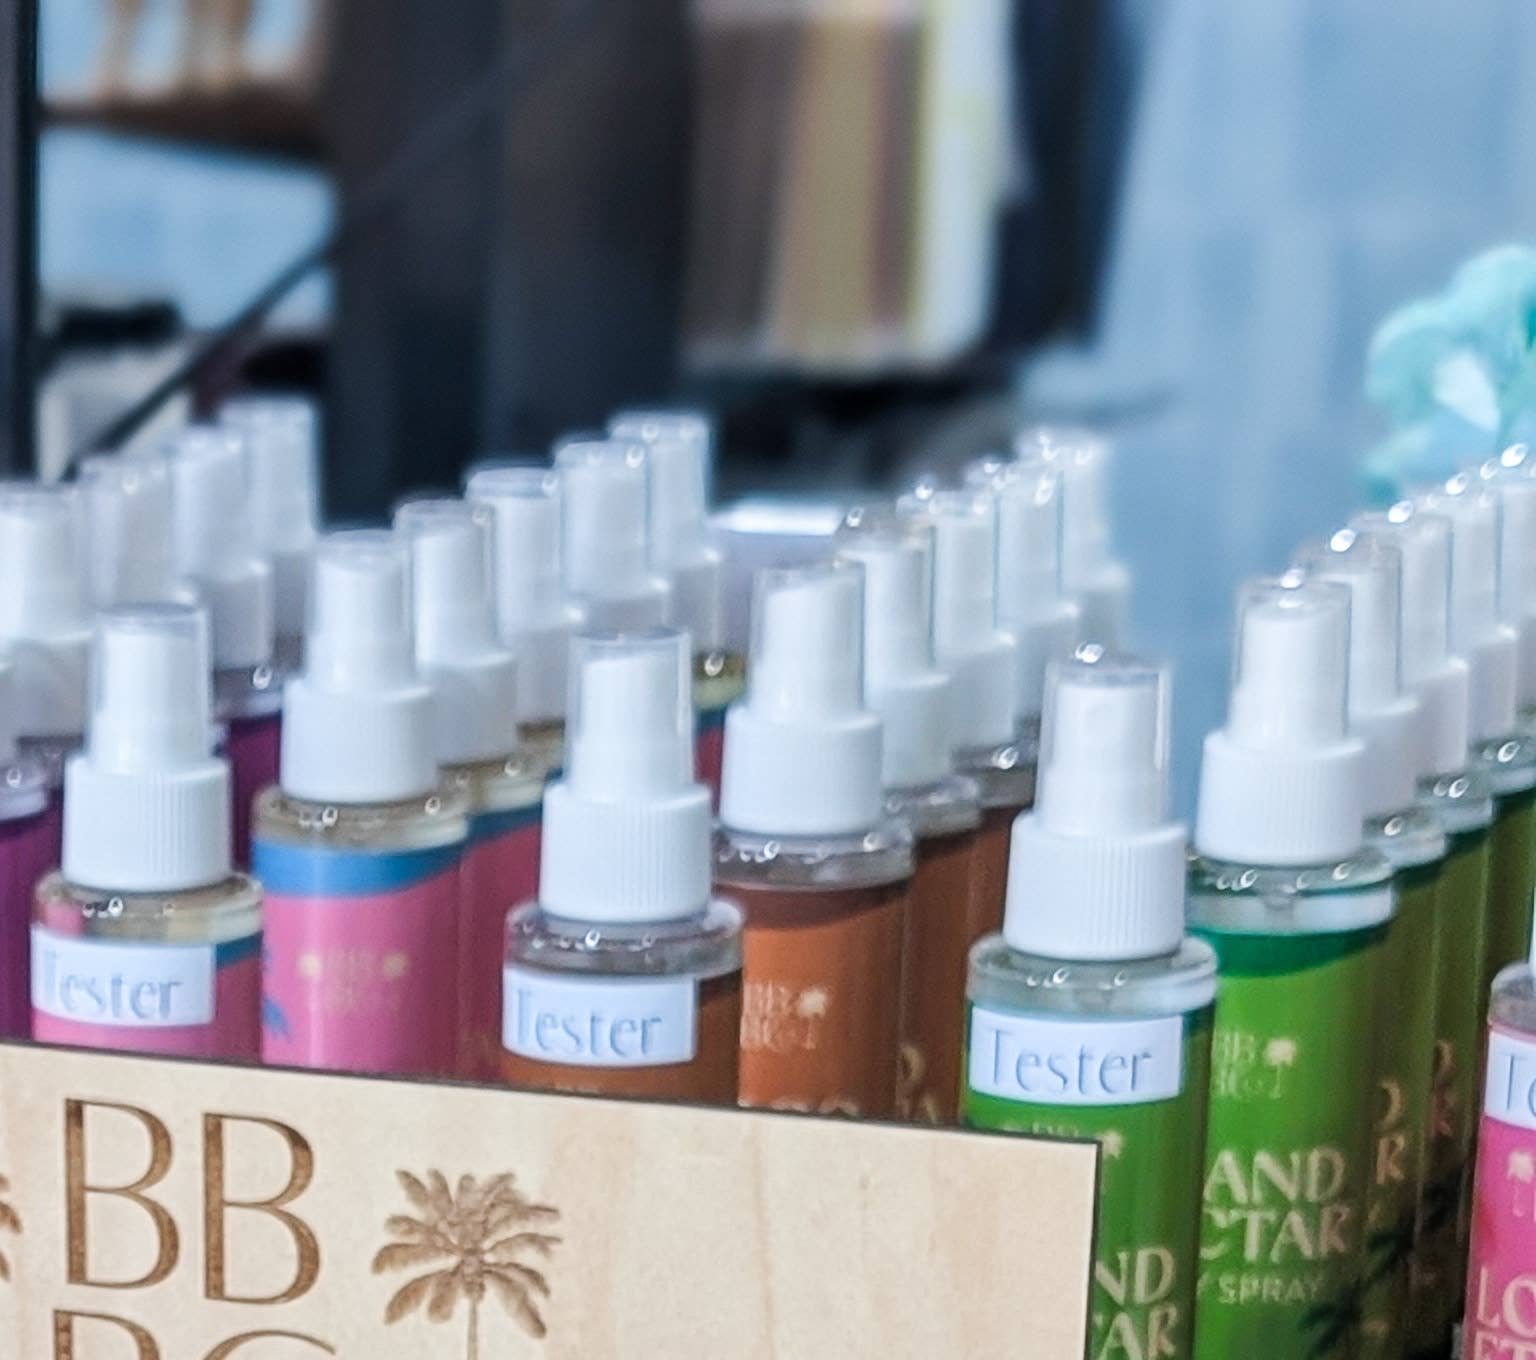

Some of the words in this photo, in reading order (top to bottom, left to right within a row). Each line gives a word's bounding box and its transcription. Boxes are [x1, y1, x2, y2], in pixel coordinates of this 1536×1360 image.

[40, 947, 183, 1020] Tester
[515, 987, 663, 1058] Tester
[984, 1027, 1152, 1095] Tester
[64, 1097, 322, 1305] BB
[1203, 1148, 1346, 1205] AND
